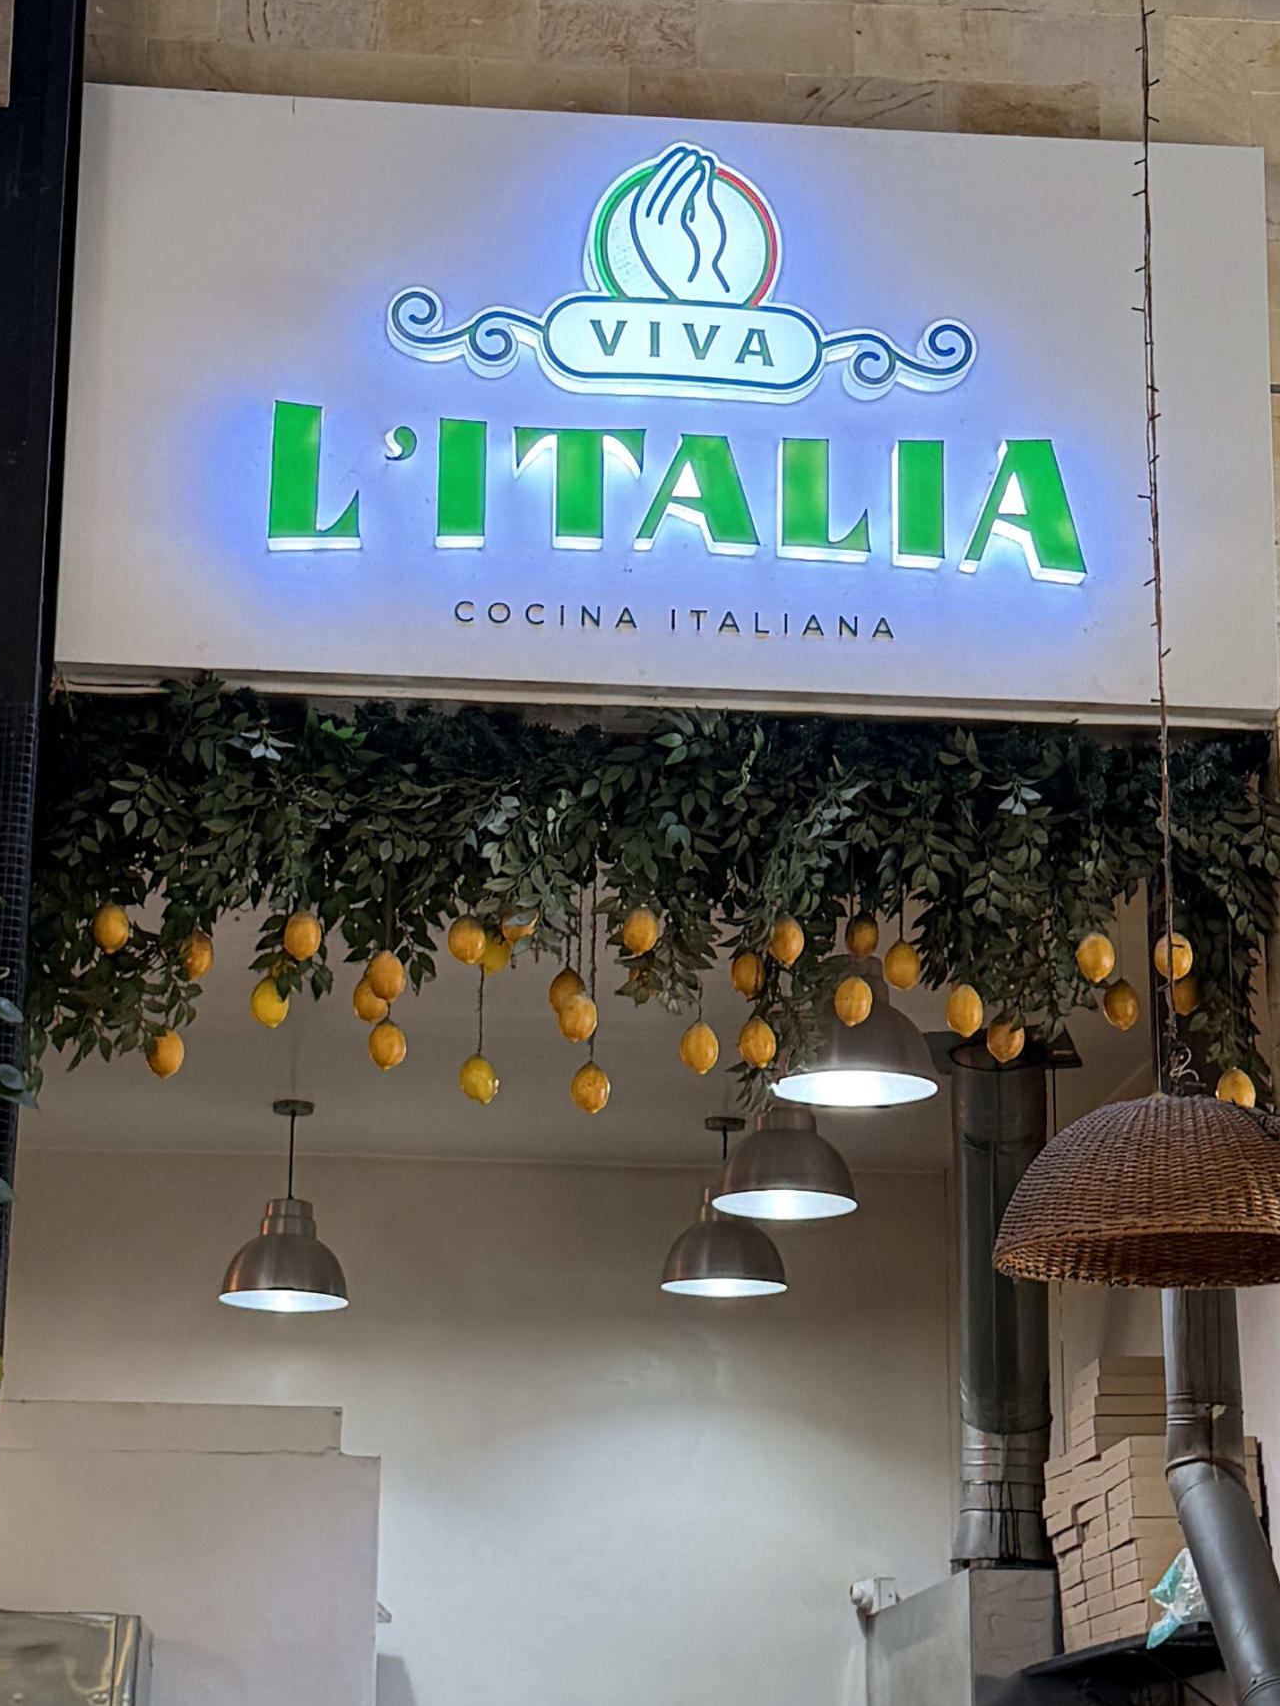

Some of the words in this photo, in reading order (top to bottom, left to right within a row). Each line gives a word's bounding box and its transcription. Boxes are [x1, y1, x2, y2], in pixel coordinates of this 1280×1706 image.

[588, 318, 778, 369] VIVA
[454, 600, 638, 629] COCINA
[670, 608, 894, 639] ITALIANA
